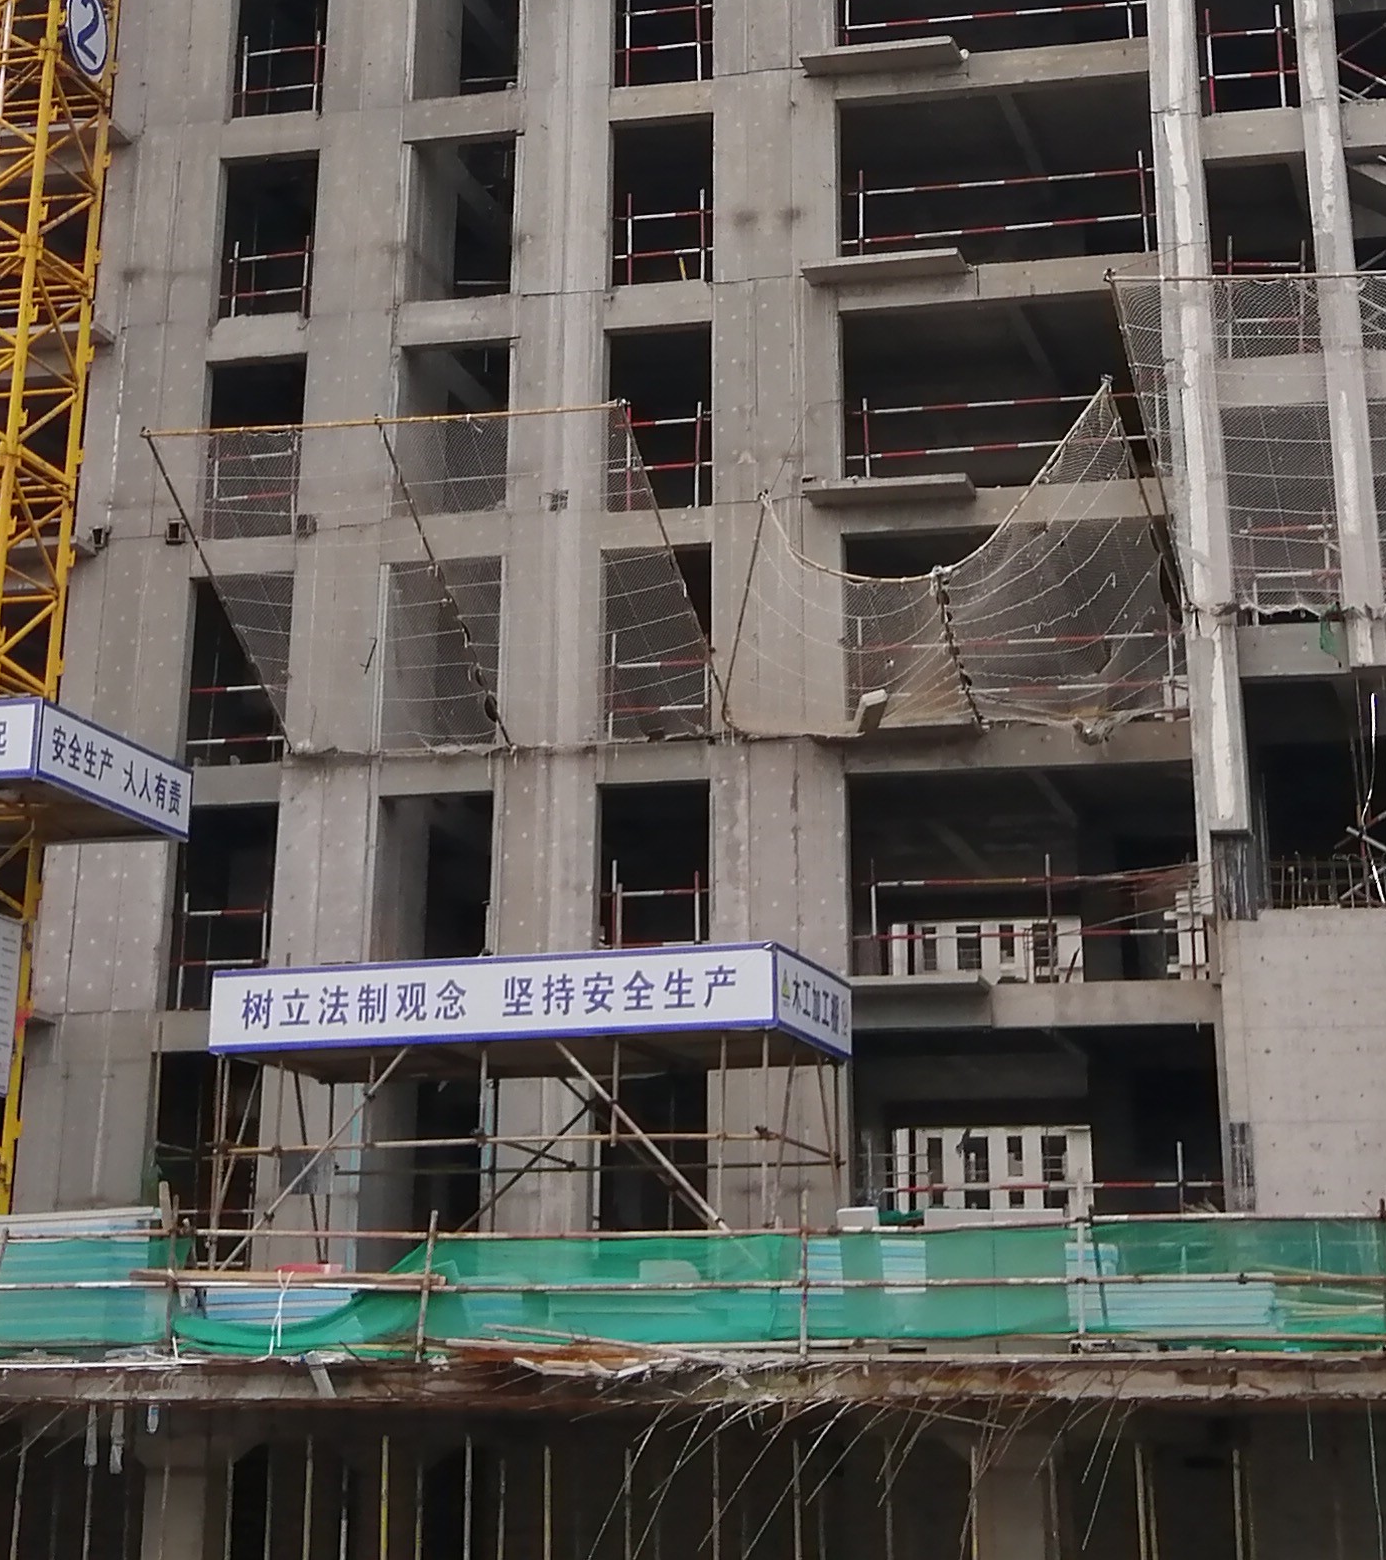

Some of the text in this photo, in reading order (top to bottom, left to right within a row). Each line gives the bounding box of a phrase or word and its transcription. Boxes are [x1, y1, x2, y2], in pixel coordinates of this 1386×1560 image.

[52, 725, 114, 781] 安全生产
[241, 964, 738, 1030] 树立法制观念 坚持安全生产
